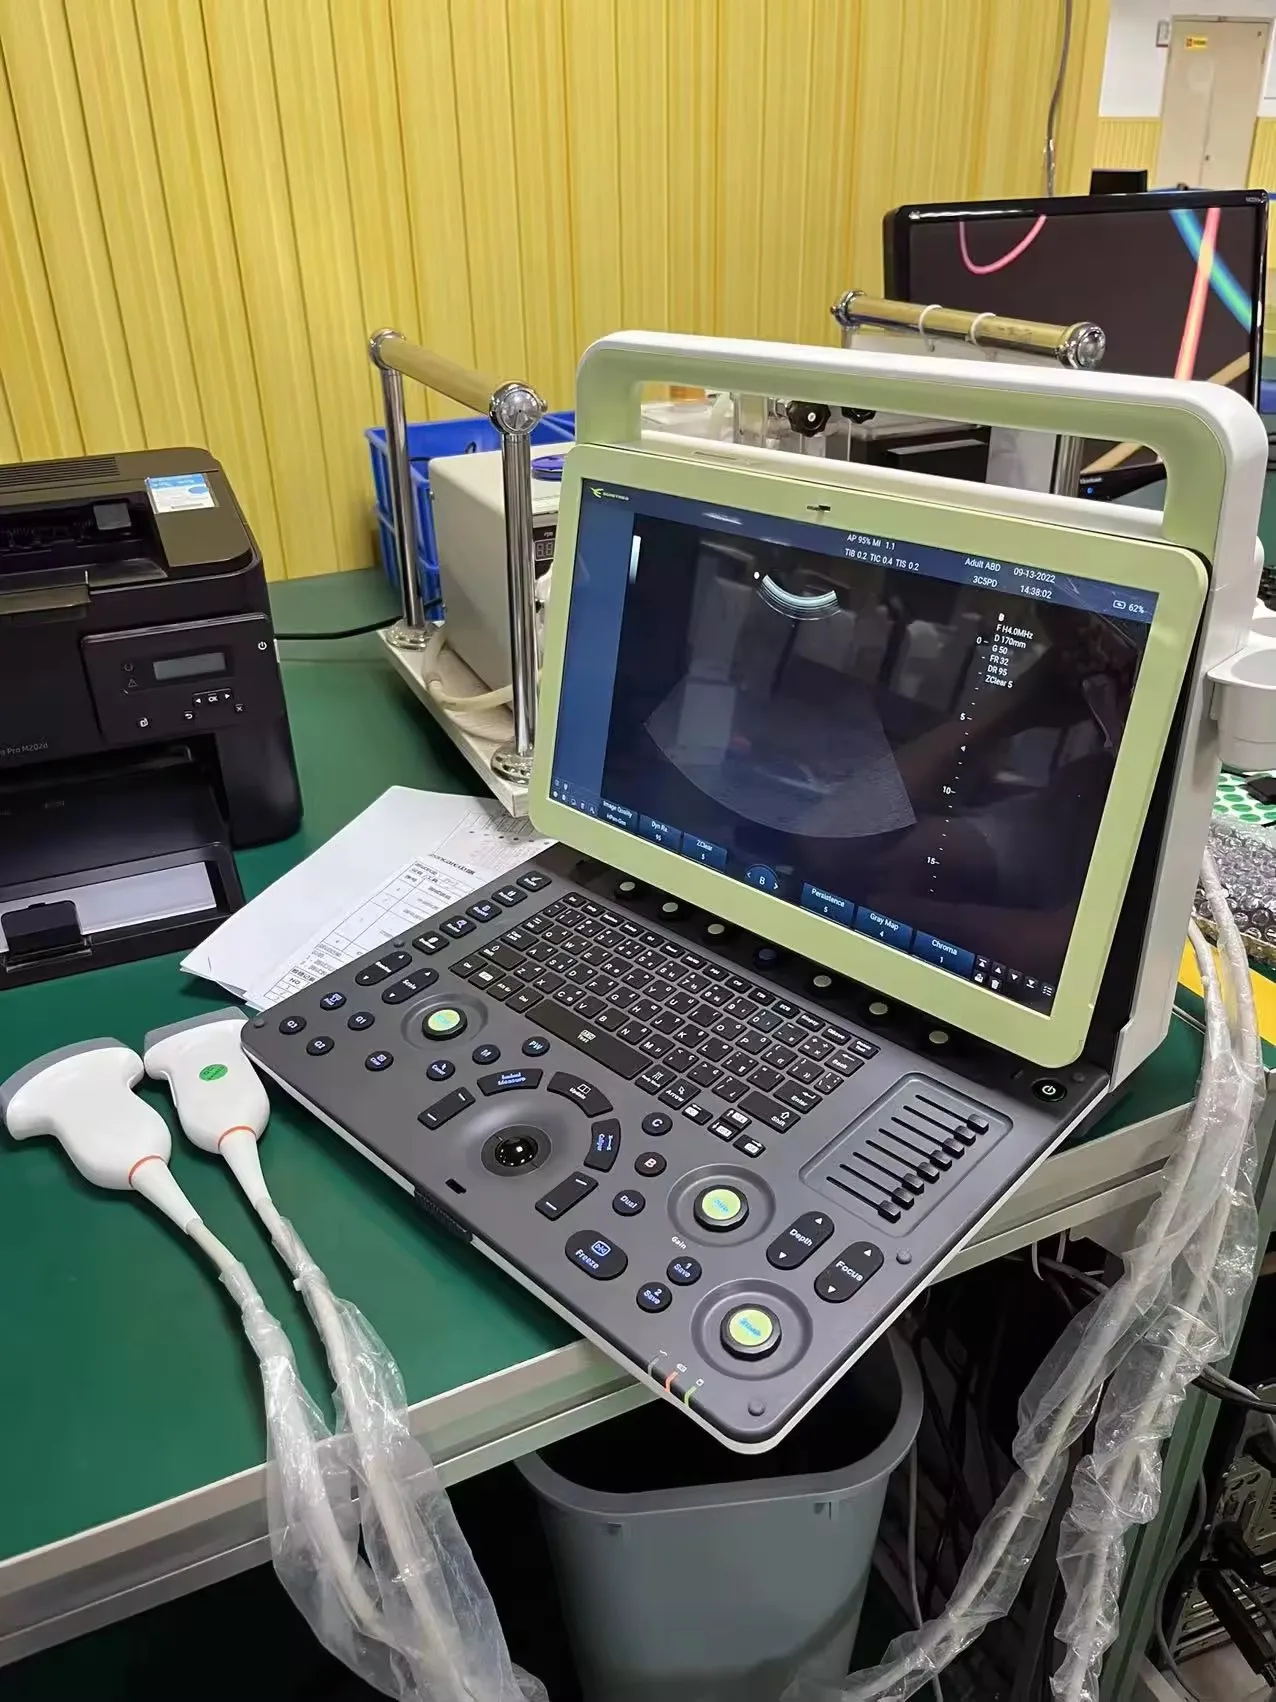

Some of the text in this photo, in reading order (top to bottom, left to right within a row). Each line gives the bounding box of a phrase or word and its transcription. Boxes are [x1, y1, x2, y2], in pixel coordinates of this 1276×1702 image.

[847, 534, 895, 550] AP 95% MI 1.1
[845, 548, 920, 571] TIB 0.2 TIC 0.4 TIS 0.2
[964, 558, 1001, 572] Adult ABD
[1014, 567, 1056, 584] 09-13-2022
[972, 576, 998, 588] 3C5PD
[1020, 585, 1052, 600] 14:38:02
[1128, 604, 1144, 614] 62%
[998, 613, 1005, 622] B
[1002, 625, 1034, 640] H4.0MHz
[976, 636, 982, 644] 0
[994, 634, 1026, 648] D 170mm
[998, 646, 1008, 654] 50
[990, 654, 1009, 666] FR 32
[988, 664, 1008, 676] DR 95
[985, 674, 1014, 688] ZClear 5
[942, 785, 952, 794] 10
[652, 820, 660, 830] Dyn
[926, 856, 936, 865] 15
[759, 876, 766, 885] B
[811, 888, 845, 908] Persistence
[870, 912, 900, 931] Gray Map
[932, 938, 958, 956] Chroma
[669, 998, 678, 1006] U
[620, 1028, 630, 1036] N
[528, 1040, 543, 1050] PW
[644, 1042, 654, 1050] M
[702, 1044, 708, 1052] L
[832, 1059, 848, 1070] Back
[666, 1089, 684, 1102] Arrow
[791, 1096, 808, 1107] Enter
[652, 1118, 663, 1127] C
[771, 1116, 786, 1126] Shift
[644, 1158, 657, 1168] B
[620, 1195, 638, 1208] Dual
[671, 1236, 687, 1250] Gain
[790, 1228, 812, 1247] Depth
[575, 1248, 600, 1270] Freeze
[674, 1263, 690, 1278] Save
[836, 1260, 864, 1282] Focus
[643, 1290, 660, 1304] Save
[654, 1288, 662, 1296] 2
